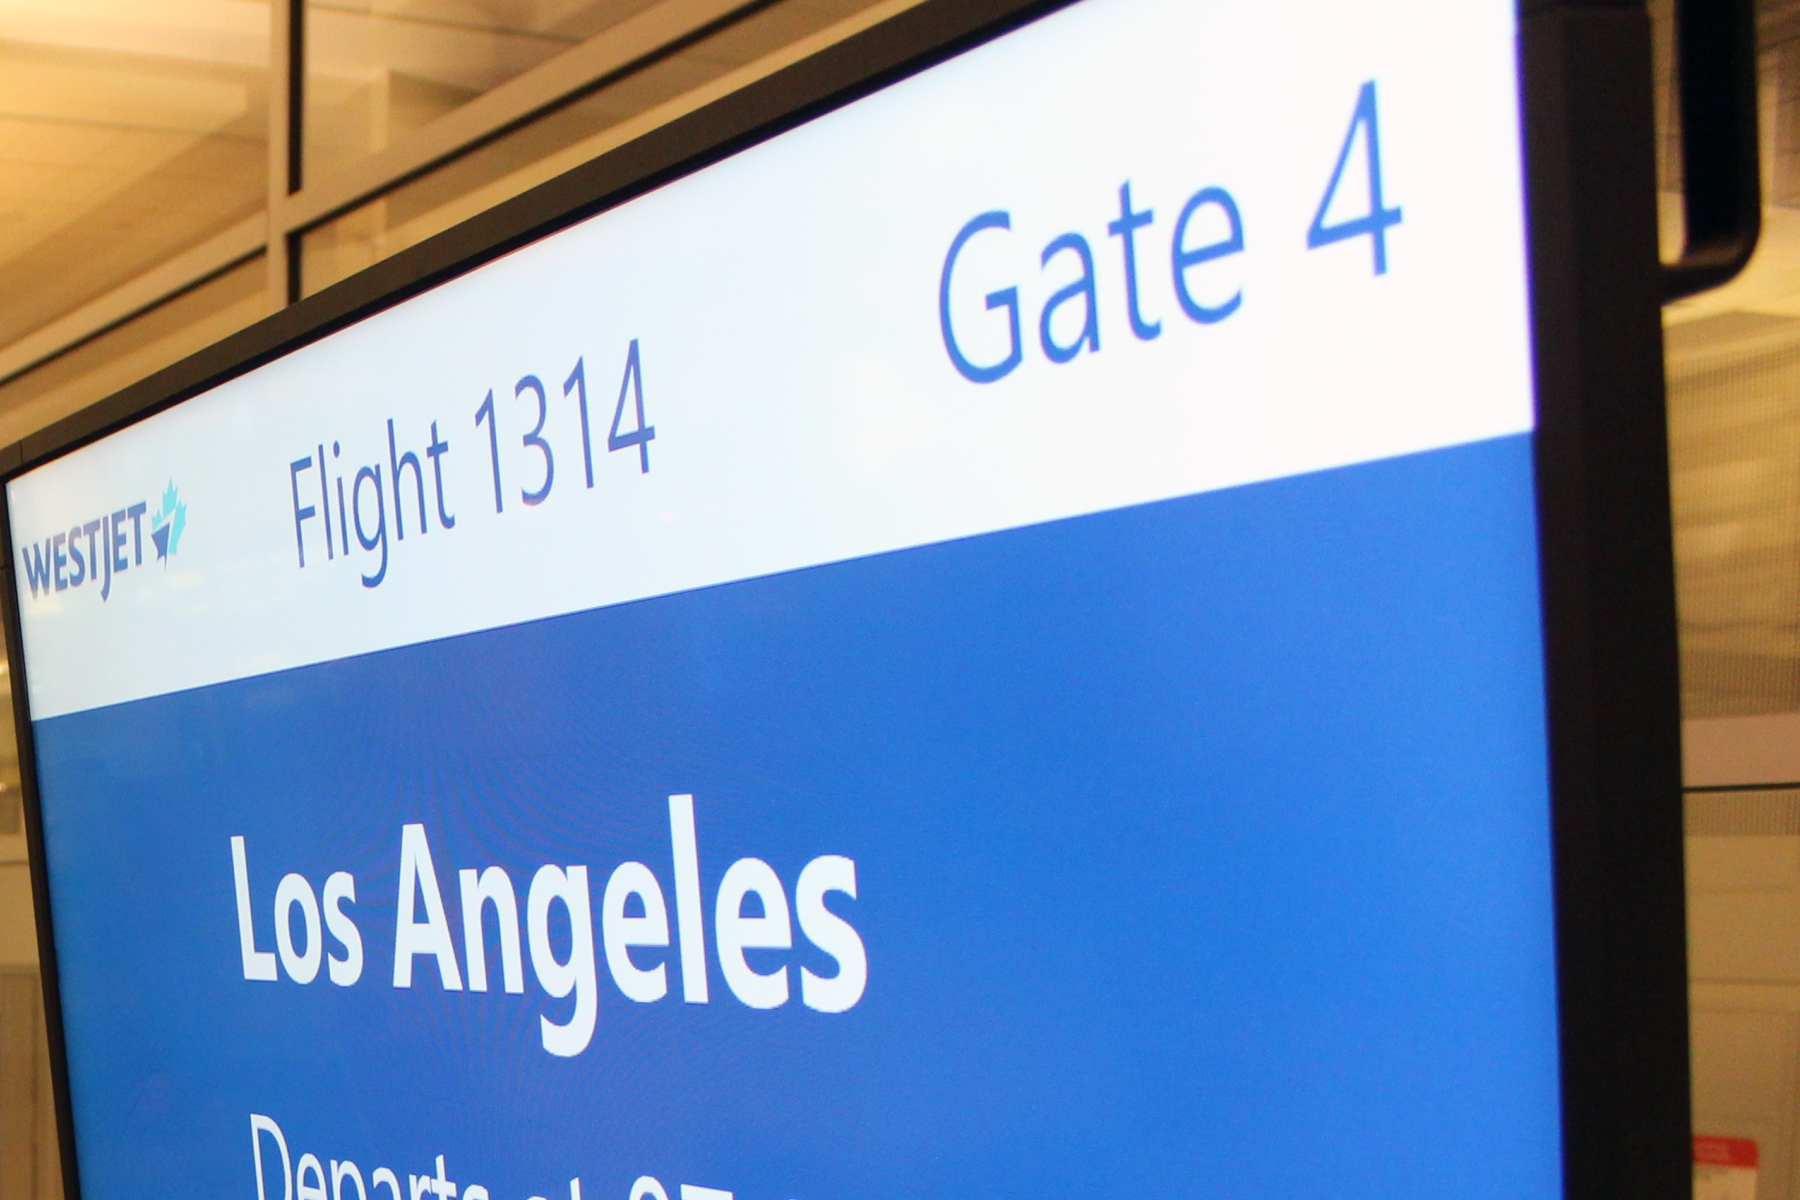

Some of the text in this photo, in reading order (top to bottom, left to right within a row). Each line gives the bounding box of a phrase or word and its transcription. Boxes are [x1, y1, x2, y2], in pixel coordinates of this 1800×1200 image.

[939, 79, 1402, 385] Gate 4
[21, 500, 147, 603] WESTJET
[290, 338, 656, 589] Flight 1314
[230, 794, 867, 1058] Los Angeles
